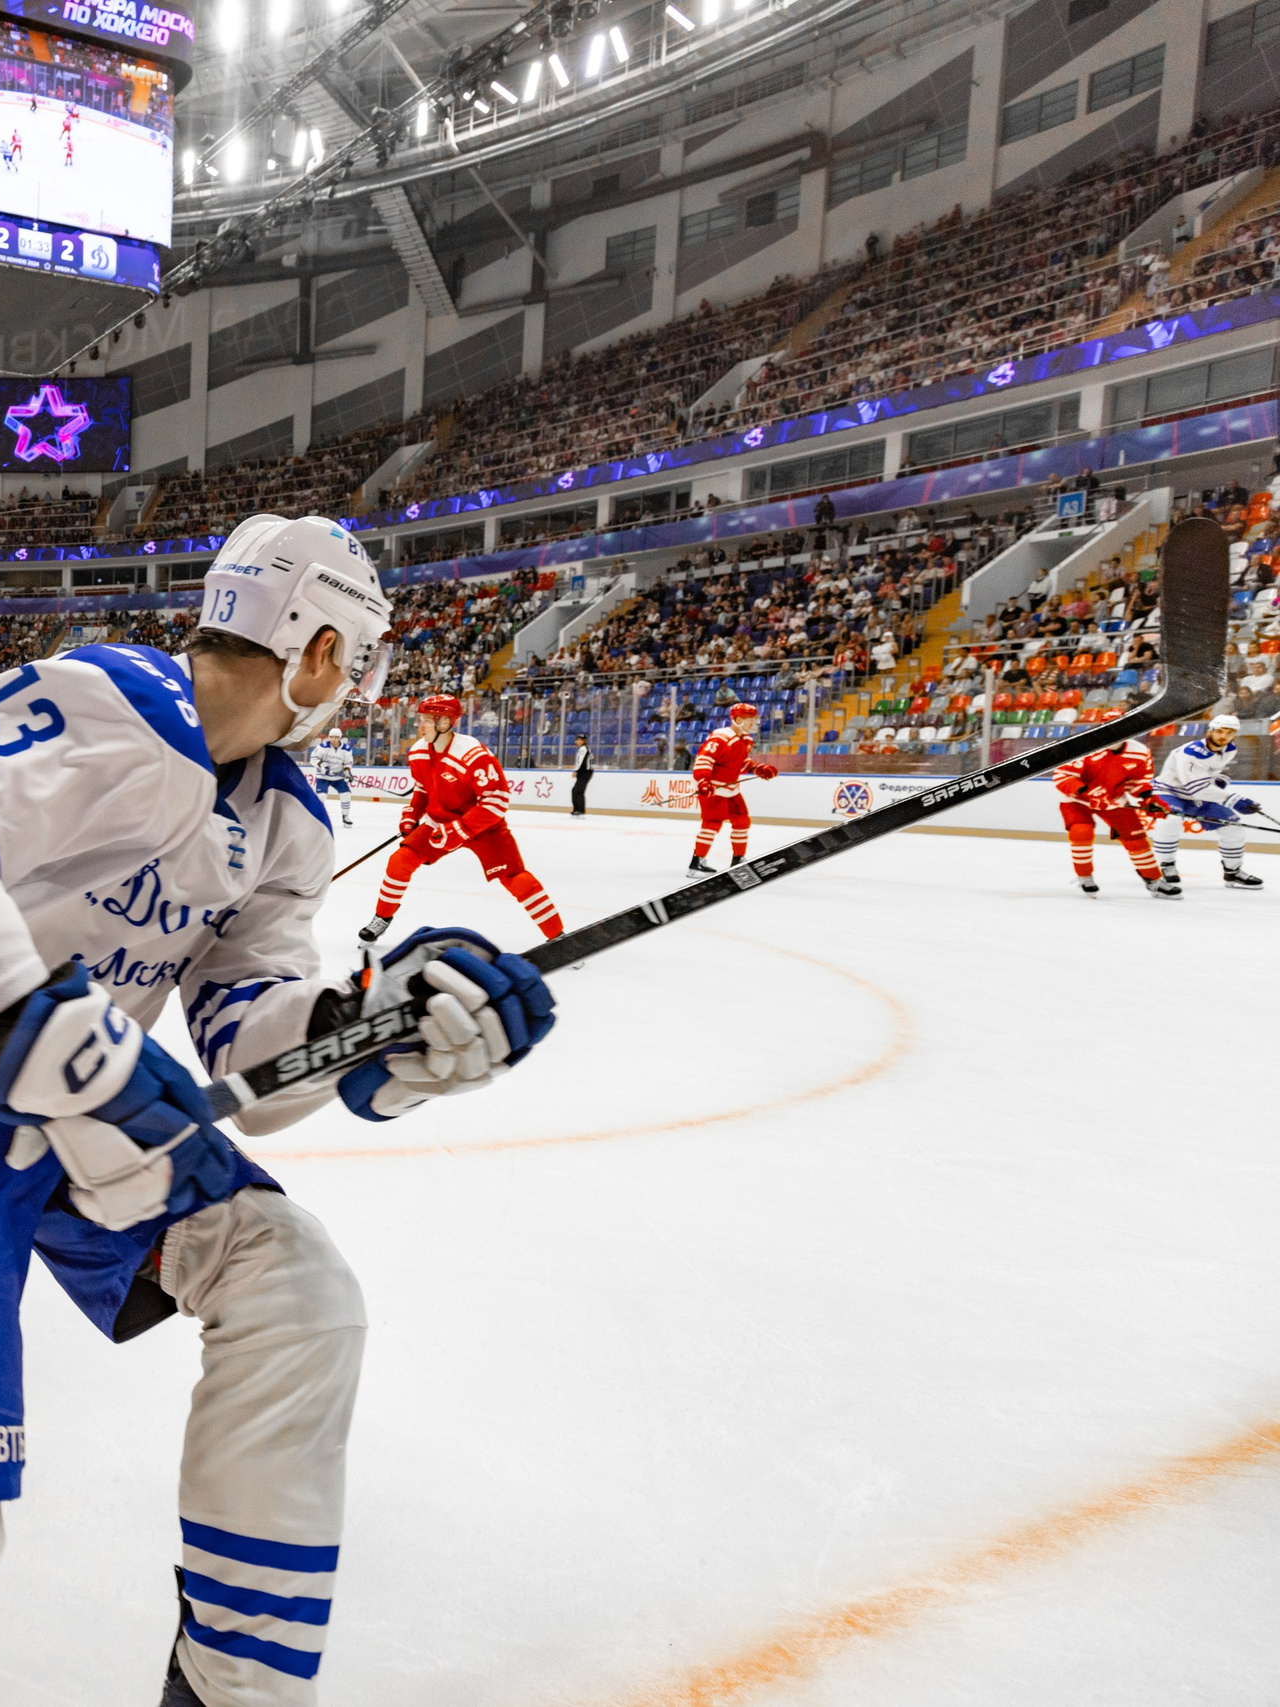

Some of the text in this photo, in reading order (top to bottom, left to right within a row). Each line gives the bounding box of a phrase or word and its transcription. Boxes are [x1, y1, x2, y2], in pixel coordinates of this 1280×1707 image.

[62, 2, 170, 46] ПО ХОККЕЮ
[20, 238, 50, 252] 01:33
[61, 240, 74, 261] 2
[318, 573, 366, 602] BAUER
[209, 589, 237, 623] 13
[388, 776, 408, 790] ПО
[474, 764, 499, 787] 34
[487, 865, 508, 875] CCM
